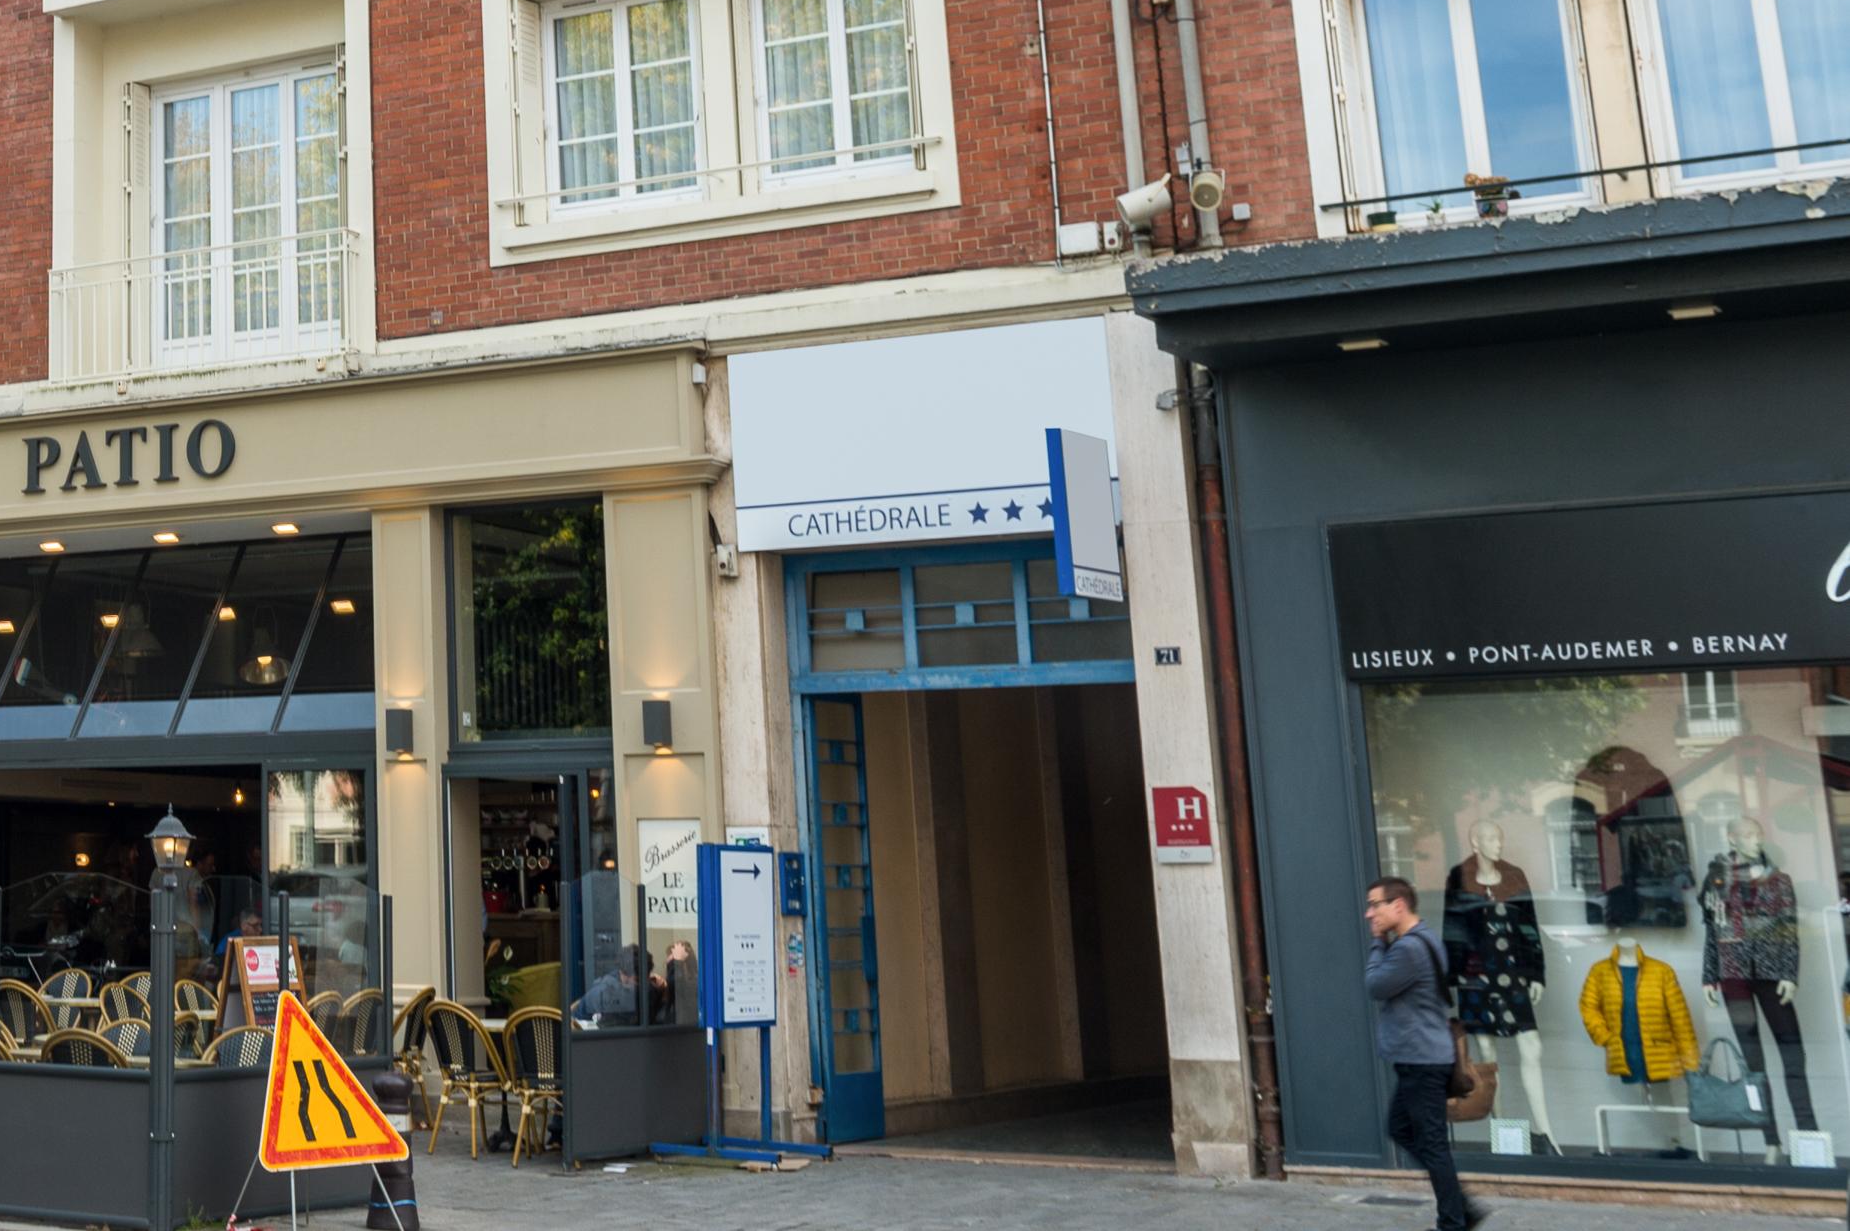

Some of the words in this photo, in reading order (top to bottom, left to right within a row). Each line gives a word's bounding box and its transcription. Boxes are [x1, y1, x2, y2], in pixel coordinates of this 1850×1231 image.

[21, 419, 236, 494] PATIO
[788, 504, 951, 537] CATHÉDRALE
[1160, 649, 1175, 663] 71
[1351, 649, 1435, 669] LISIEUX
[1468, 638, 1655, 664] PONT-AUDEMER
[1691, 633, 1789, 655] BERNAY
[1177, 796, 1203, 820] H
[644, 830, 697, 873] Brasserie
[662, 872, 685, 889] LE
